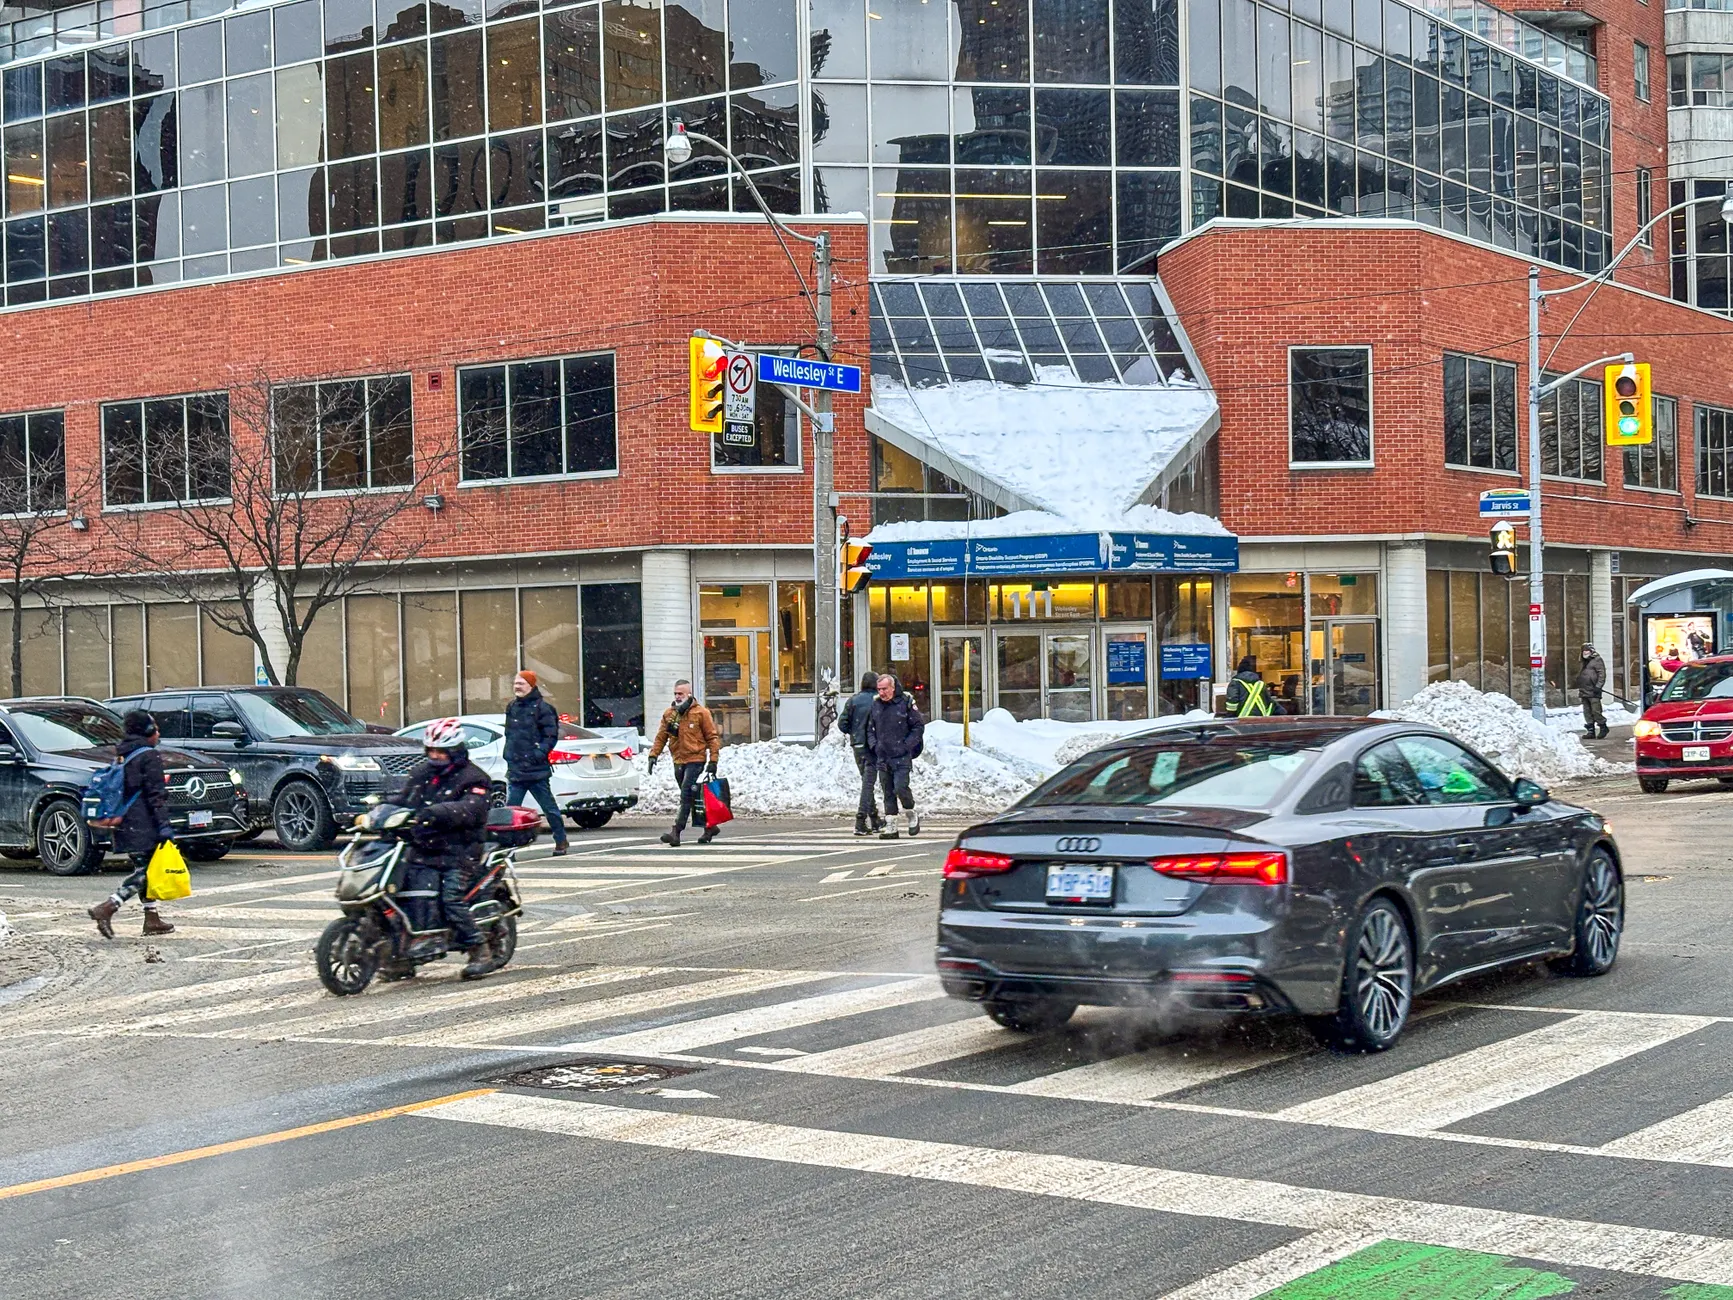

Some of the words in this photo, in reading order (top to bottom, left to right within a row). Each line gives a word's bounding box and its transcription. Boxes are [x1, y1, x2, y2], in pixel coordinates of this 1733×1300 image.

[773, 358, 827, 386] Wellesley
[828, 366, 835, 376] St
[836, 368, 844, 384] E
[730, 424, 748, 434] BUSES
[726, 433, 752, 443] EXCEPTED
[1491, 501, 1512, 510] Jarvis
[1010, 591, 1052, 618] 111
